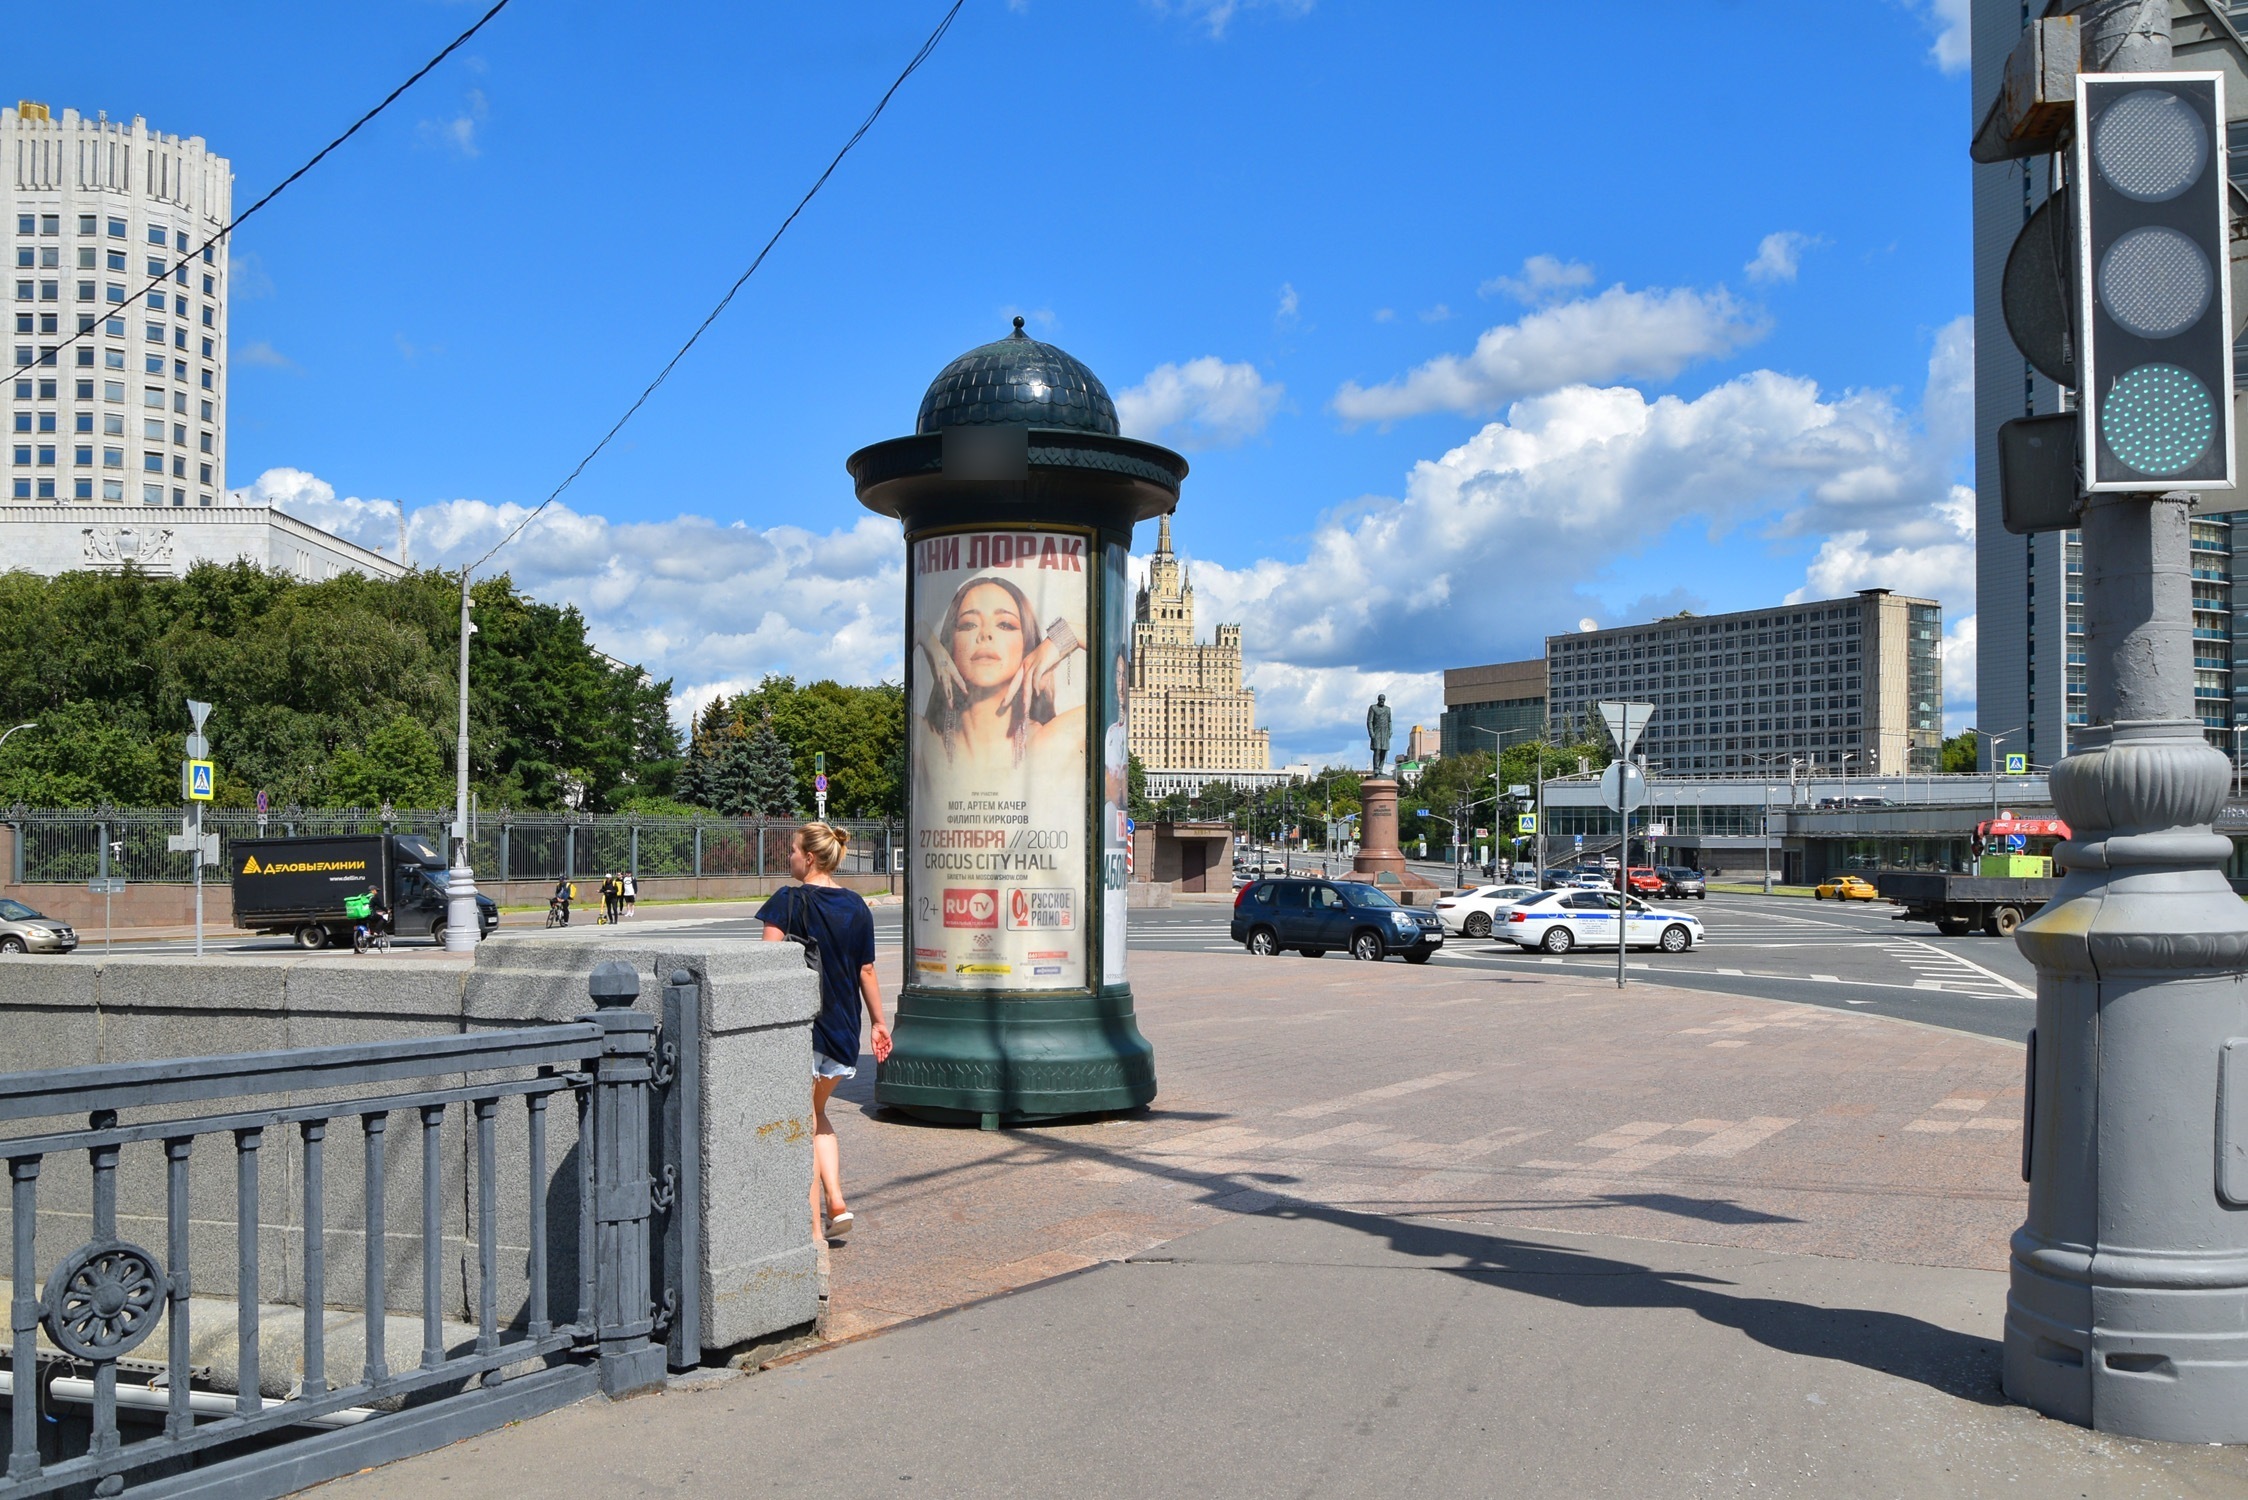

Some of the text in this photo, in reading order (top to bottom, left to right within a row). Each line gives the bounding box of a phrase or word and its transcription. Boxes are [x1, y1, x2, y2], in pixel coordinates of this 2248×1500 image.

[917, 535, 1082, 576] АНИ ЛОРАК
[948, 801, 1027, 812] МОТ, АРТЕМ КАЧЕР
[947, 814, 1029, 825] ФИЛИПП КИРКОРОВ
[920, 831, 932, 848] 27
[933, 830, 1006, 848] СЕНТЯБРЯ
[1027, 830, 1069, 849] 20:00
[925, 853, 1057, 870] CROCUS CITY HALL
[918, 896, 939, 922] 12+
[946, 899, 990, 914] RU TV
[1031, 892, 1070, 909] РУССКОЕ
[1031, 911, 1060, 926] РАДИО
